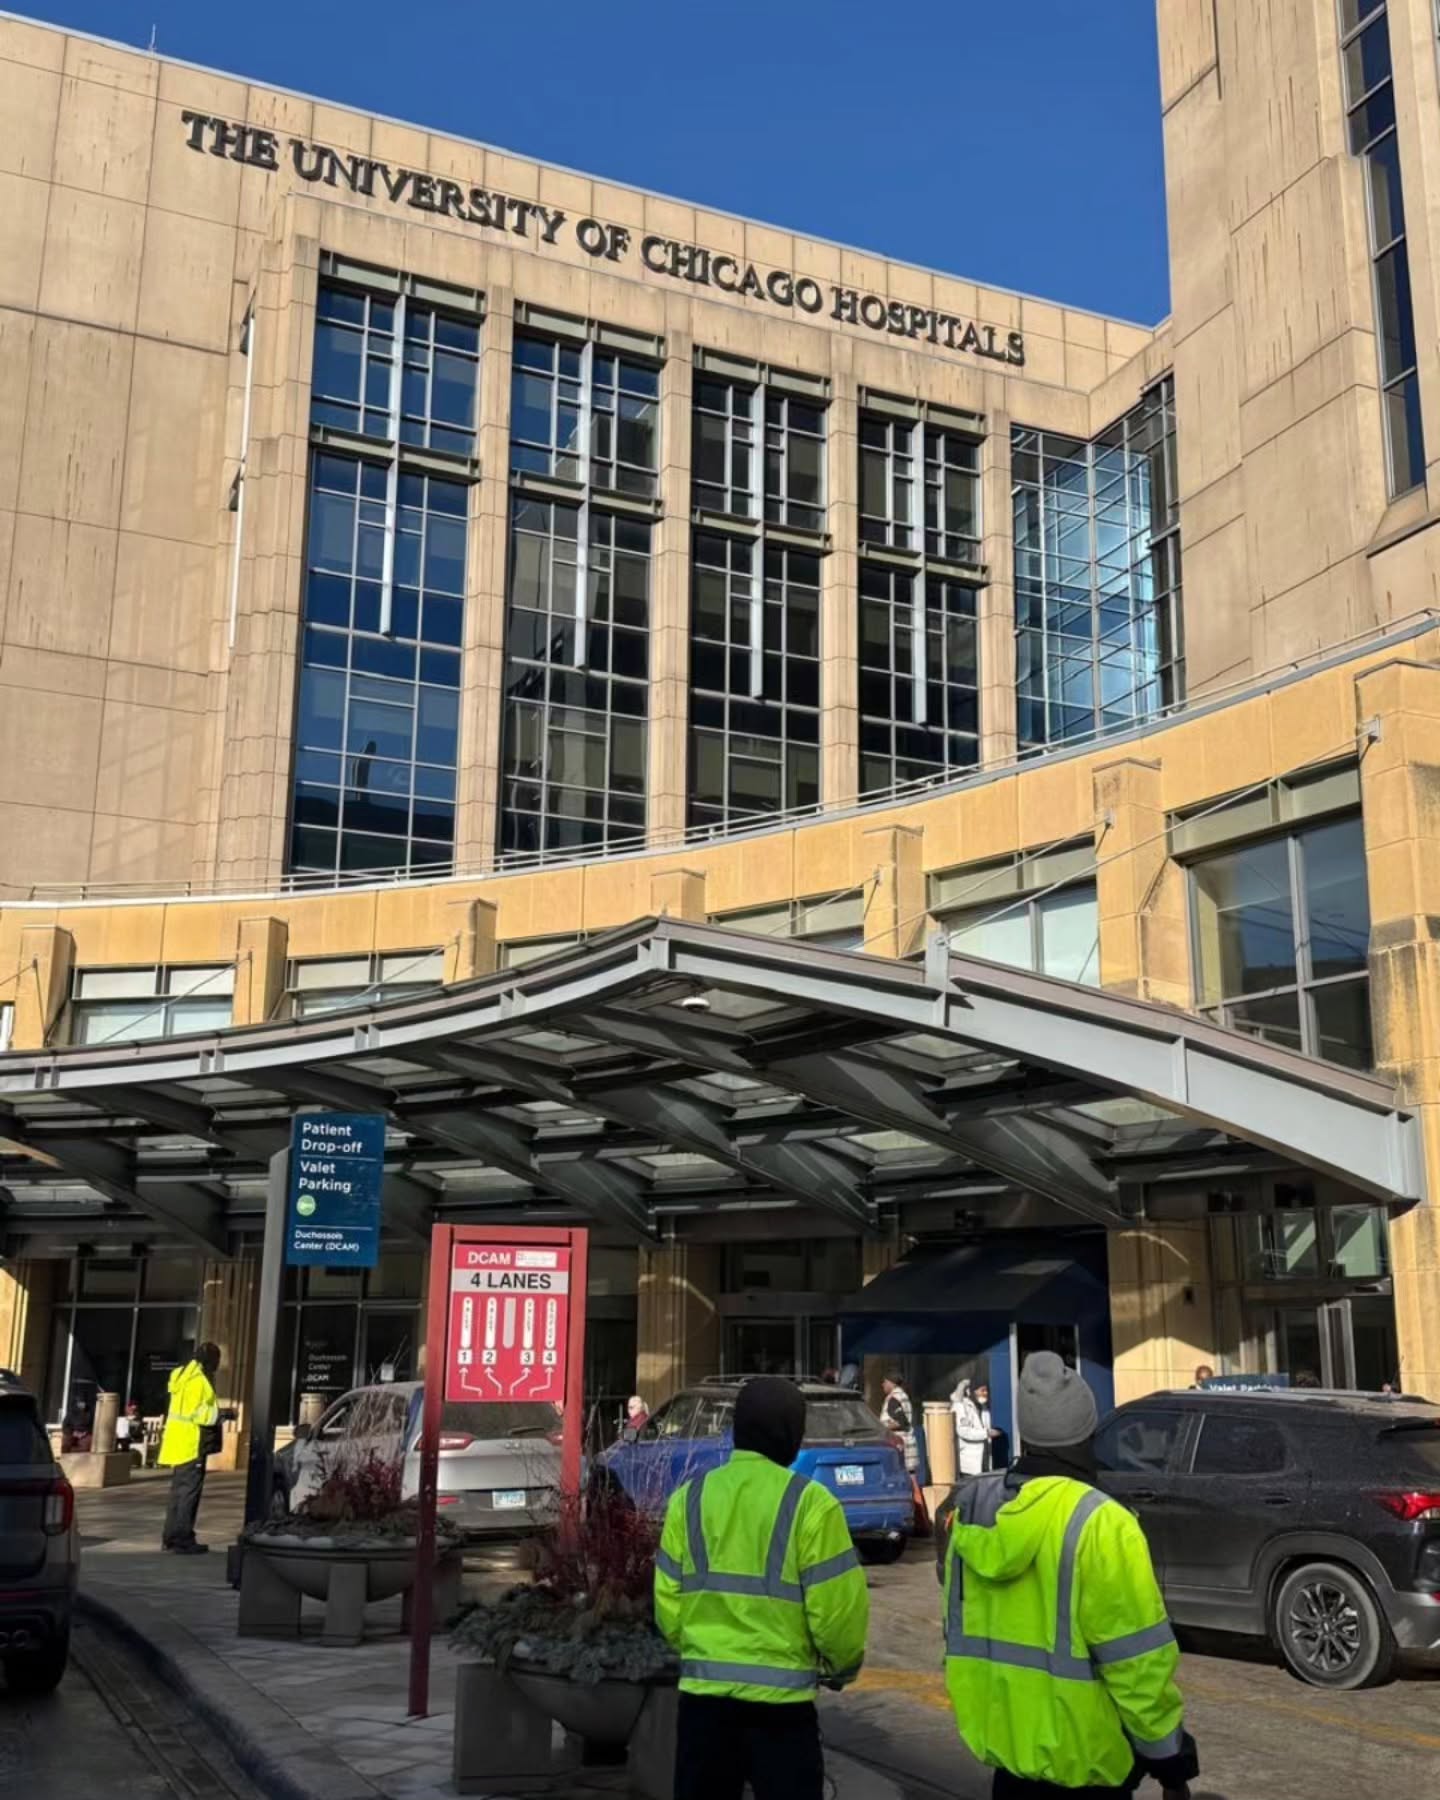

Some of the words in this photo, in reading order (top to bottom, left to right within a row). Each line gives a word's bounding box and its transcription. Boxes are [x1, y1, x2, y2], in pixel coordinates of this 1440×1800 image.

[181, 110, 280, 171] THE
[289, 137, 567, 244] UNIVERSITY
[575, 217, 631, 263] OF
[641, 235, 824, 314] CHICAGO
[829, 285, 1026, 367] HOSPITALS
[302, 1122, 352, 1136] Patient
[301, 1139, 363, 1153] Drop-off
[300, 1161, 336, 1174] Valet
[298, 1178, 352, 1193] Parking
[295, 1231, 343, 1240] Duchossois
[293, 1241, 324, 1250] Center
[325, 1242, 360, 1252] (DCAM)
[467, 1252, 511, 1265] DCAM
[470, 1272, 481, 1287] 4
[487, 1272, 552, 1289] LANES
[486, 1352, 493, 1362] 2
[524, 1352, 531, 1362] 3
[546, 1352, 553, 1362] 4
